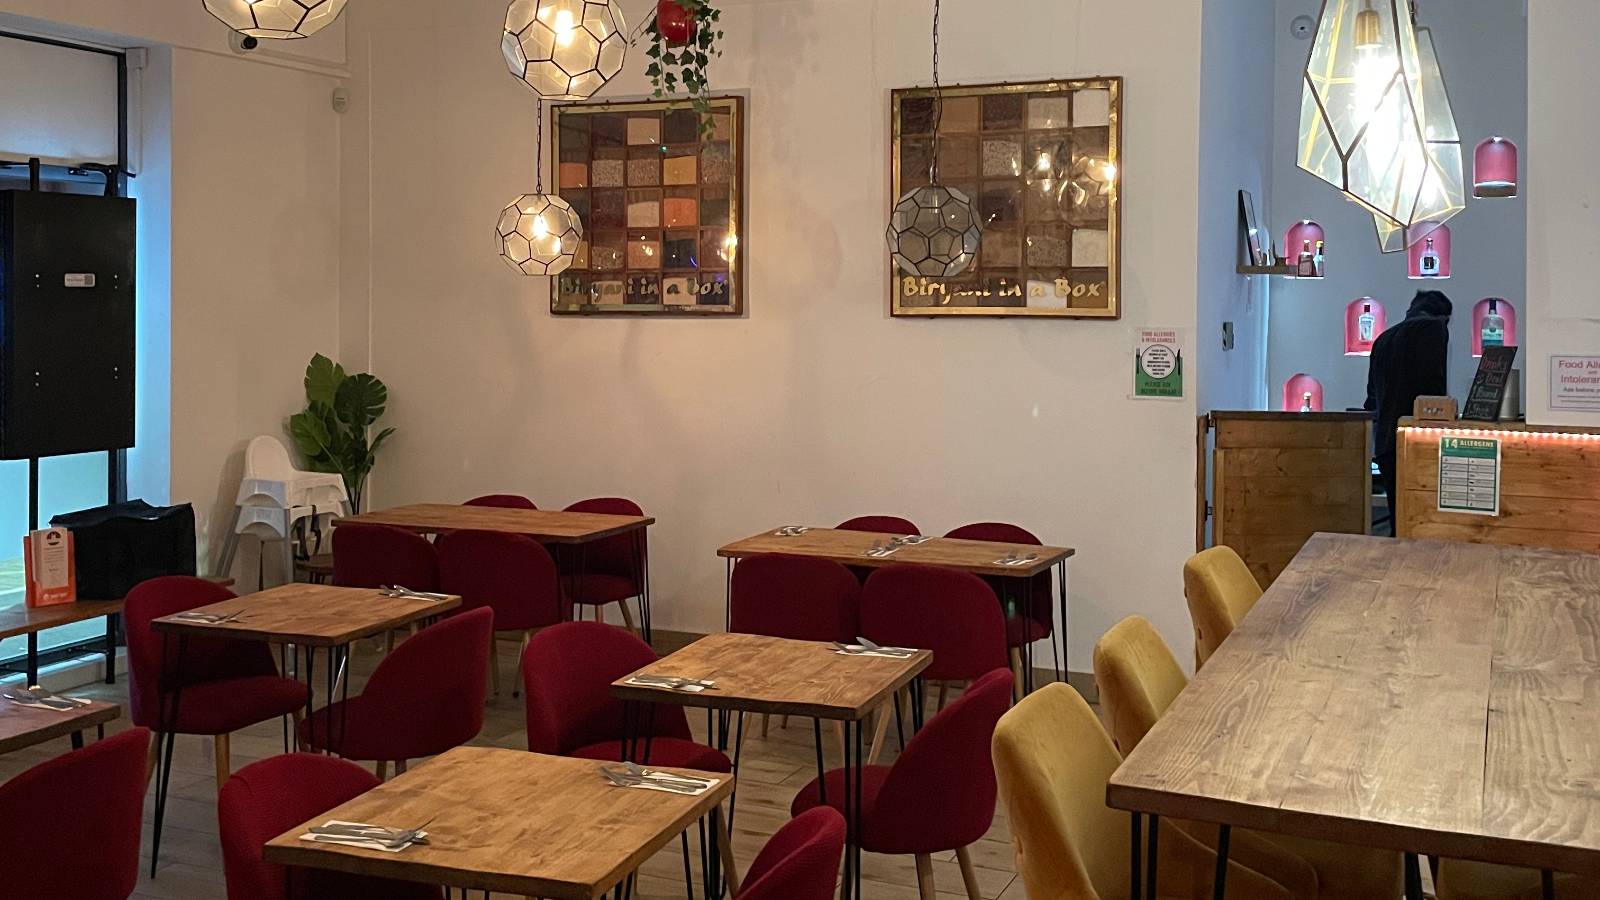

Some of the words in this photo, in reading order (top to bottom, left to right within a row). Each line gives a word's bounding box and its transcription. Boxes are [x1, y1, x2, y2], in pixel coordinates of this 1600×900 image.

[640, 278, 659, 295] in
[666, 283, 680, 295] a
[999, 278, 1022, 297] in
[1030, 284, 1046, 298] a
[1054, 276, 1104, 298] Box
[1559, 360, 1584, 369] Food
[1445, 439, 1458, 449] 14
